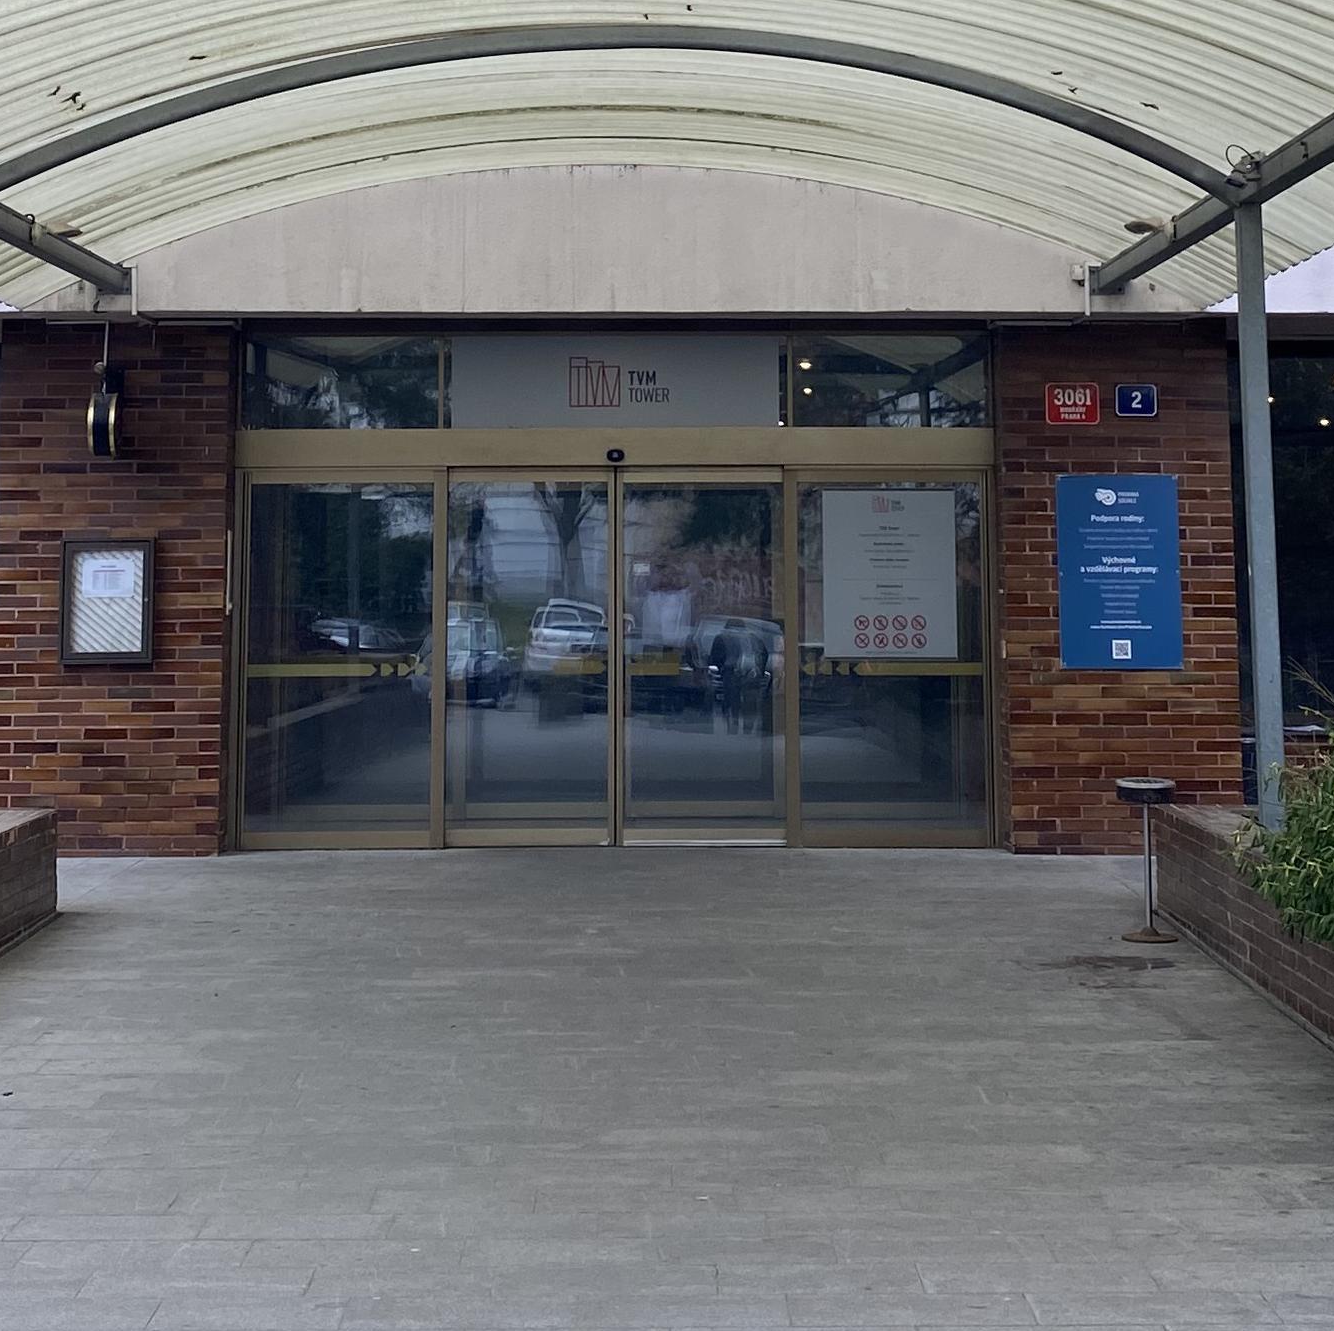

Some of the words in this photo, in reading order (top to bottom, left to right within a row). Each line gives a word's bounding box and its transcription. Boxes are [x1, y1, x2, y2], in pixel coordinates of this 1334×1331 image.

[628, 370, 656, 385] TVM
[628, 387, 670, 402] TOWER
[1054, 388, 1091, 405] 3061
[1131, 391, 1142, 408] 2
